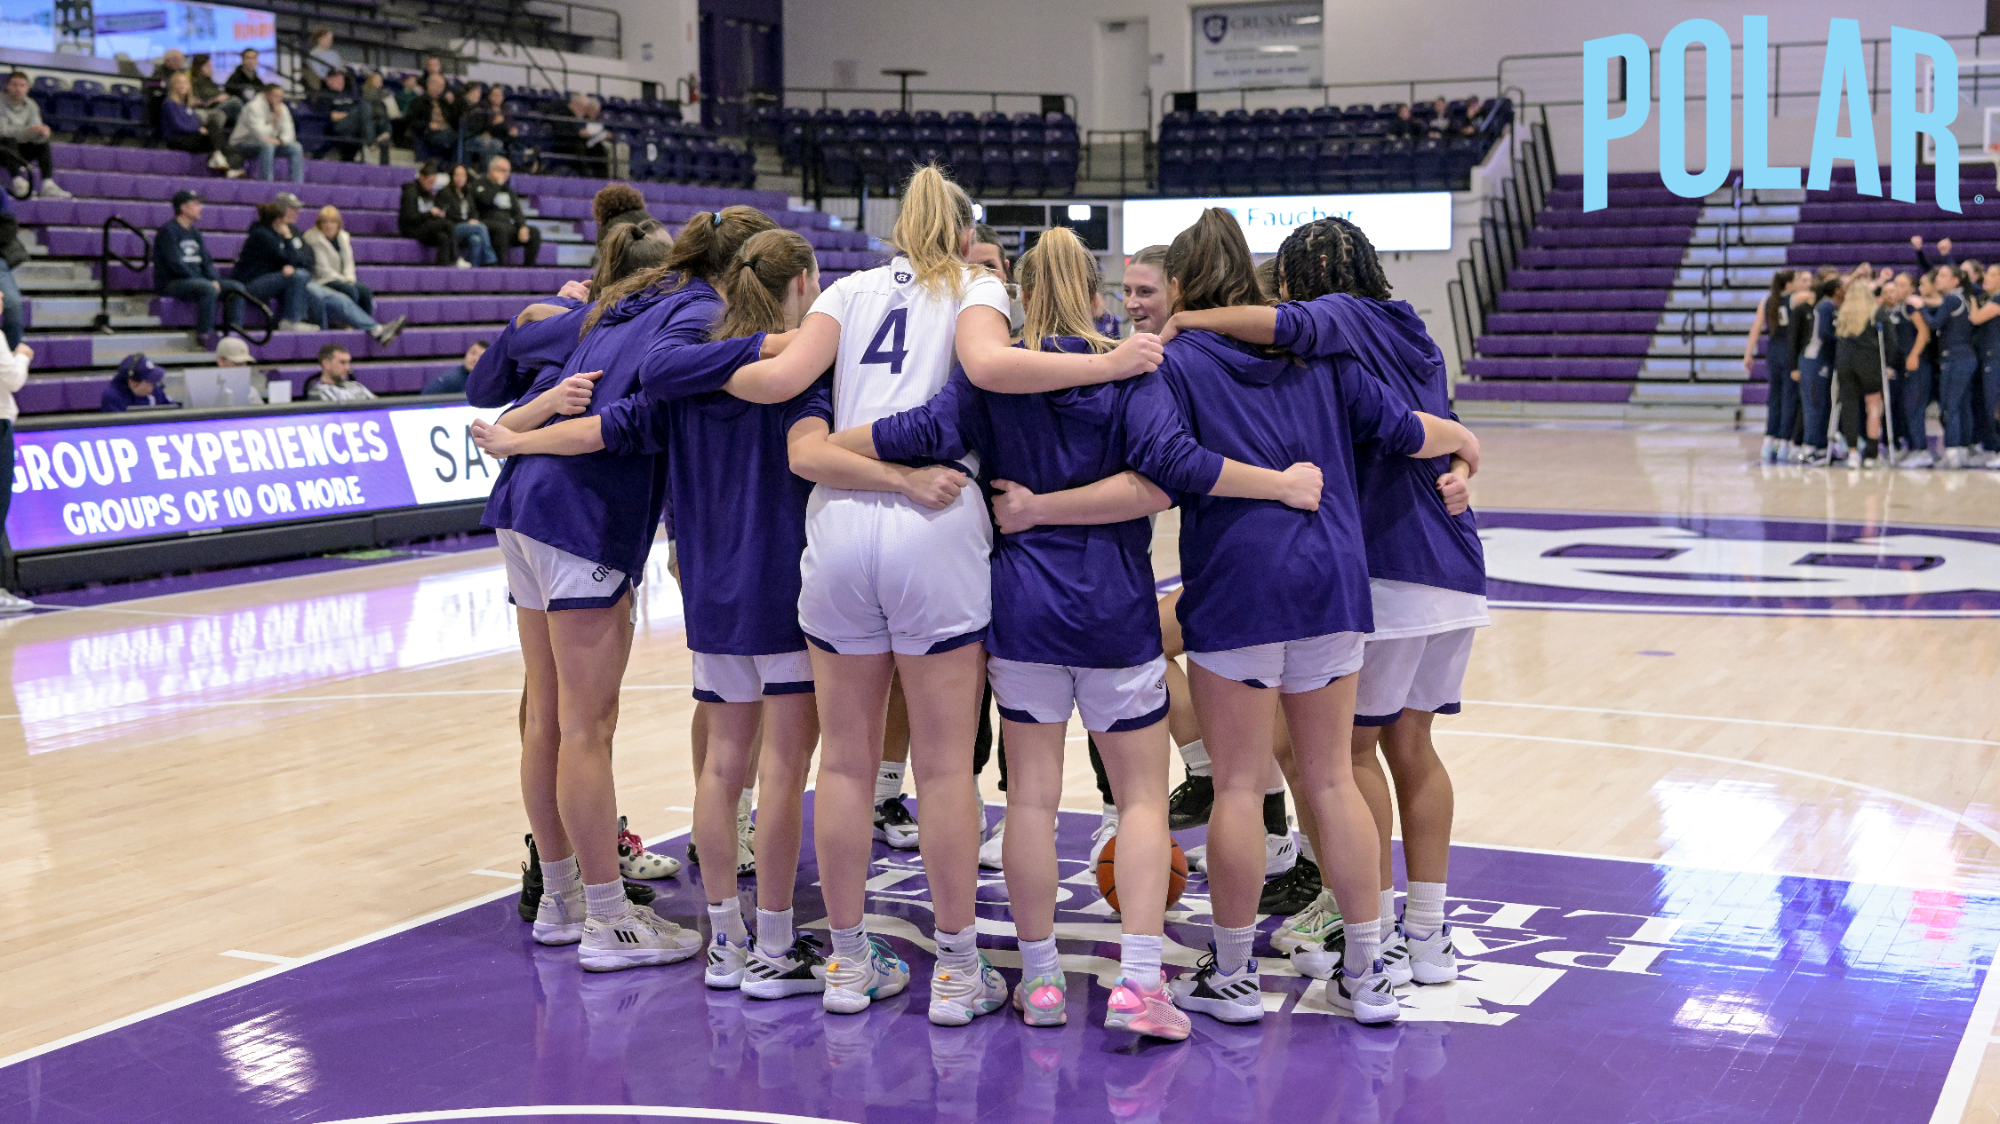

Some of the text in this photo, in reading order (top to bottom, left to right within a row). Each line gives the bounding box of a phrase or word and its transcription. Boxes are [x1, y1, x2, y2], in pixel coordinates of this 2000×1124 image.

[860, 308, 908, 374] 4
[146, 421, 388, 480] EXPERIENCES
[430, 424, 507, 482] SA
[62, 476, 365, 536] GROUPS OF 10 OR MORE
